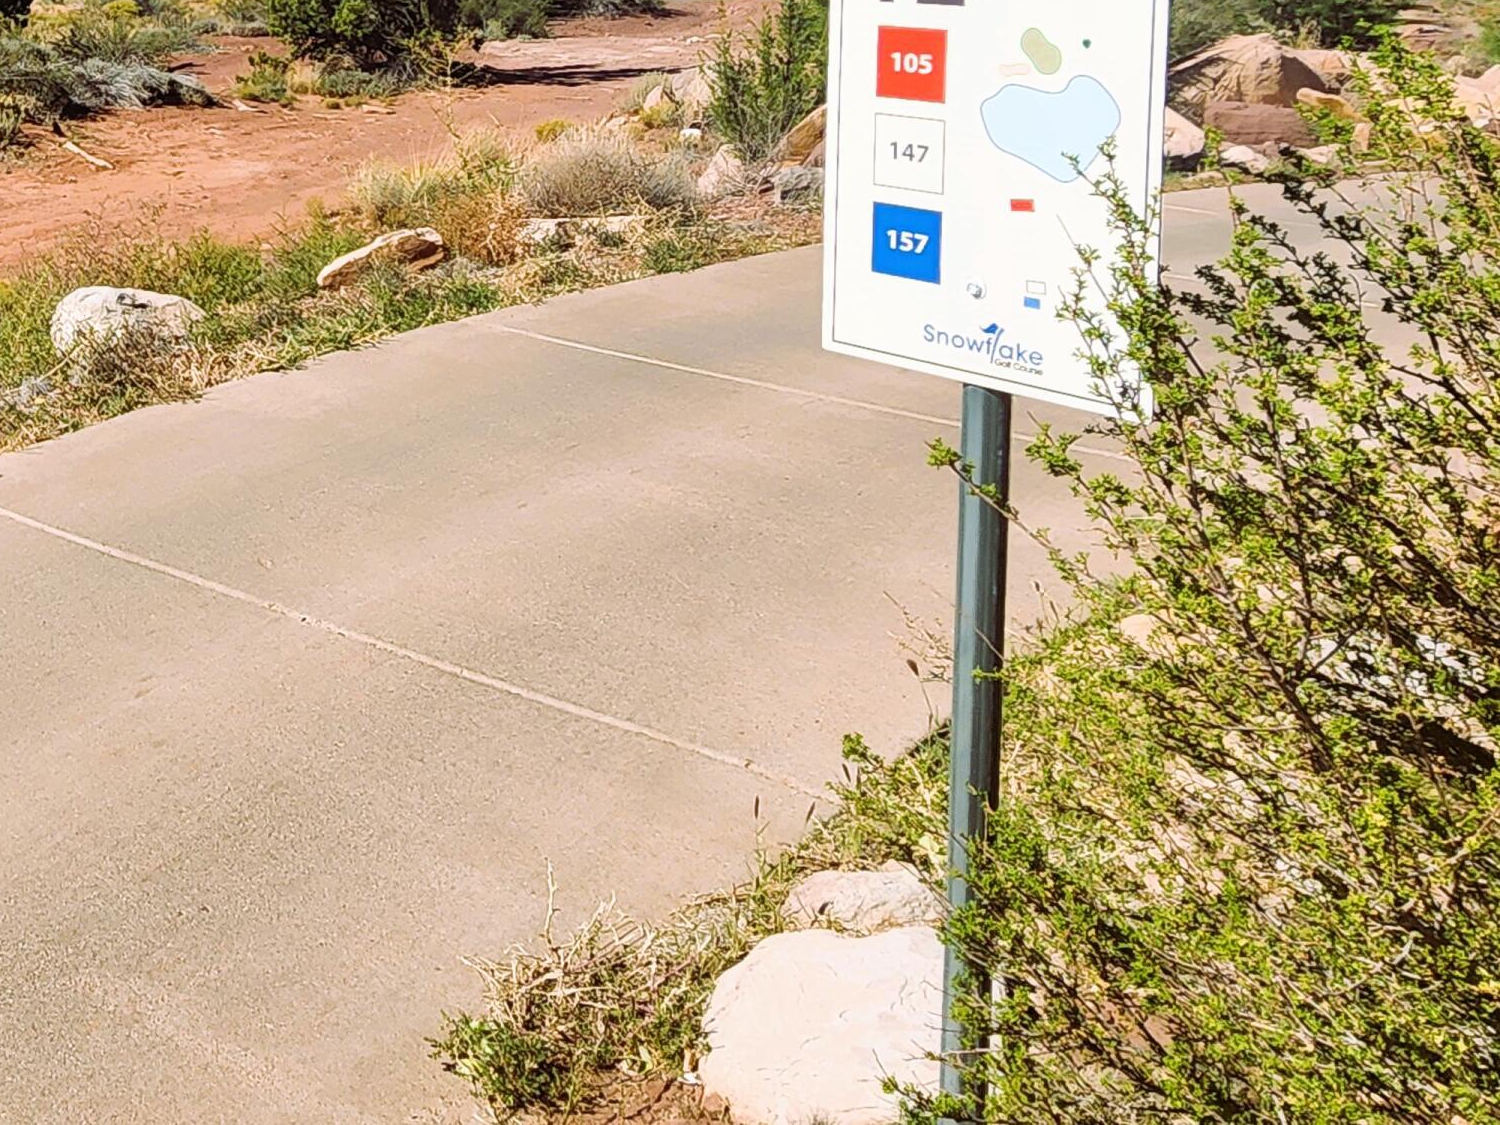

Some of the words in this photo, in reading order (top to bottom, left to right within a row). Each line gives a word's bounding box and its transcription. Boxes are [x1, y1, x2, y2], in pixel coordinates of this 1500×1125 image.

[891, 52, 932, 74] 105
[890, 142, 929, 162] 147
[886, 230, 929, 254] 157
[924, 324, 1043, 365] Snowflake
